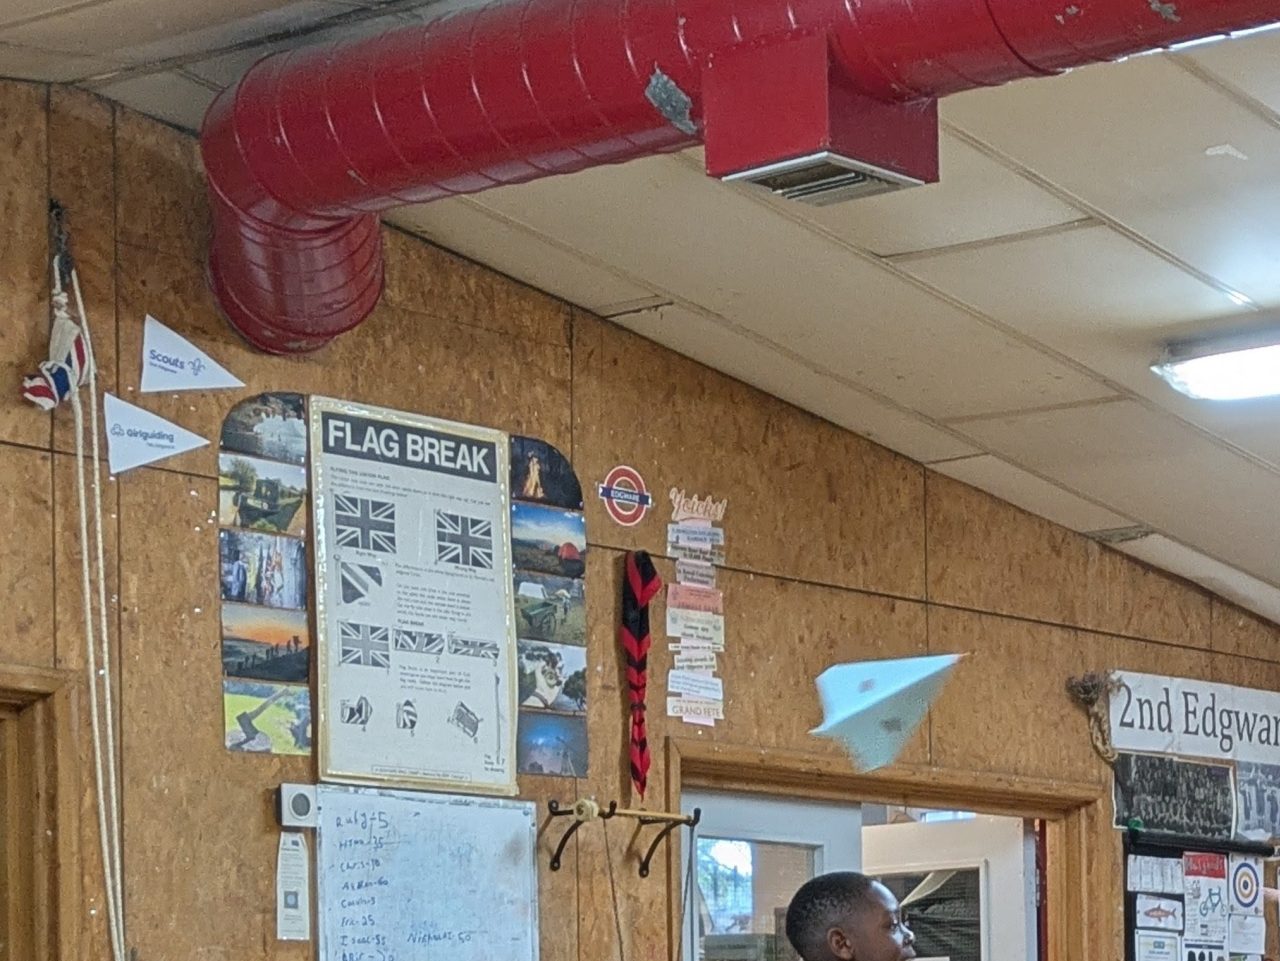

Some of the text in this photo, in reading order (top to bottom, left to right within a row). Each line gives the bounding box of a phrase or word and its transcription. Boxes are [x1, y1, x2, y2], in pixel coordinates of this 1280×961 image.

[150, 349, 185, 369] Scouts
[127, 428, 174, 443] Girlguiding
[328, 419, 491, 476] FLAG BREAK
[610, 490, 640, 503] EDGWARE
[1119, 683, 1173, 734] 2nd
